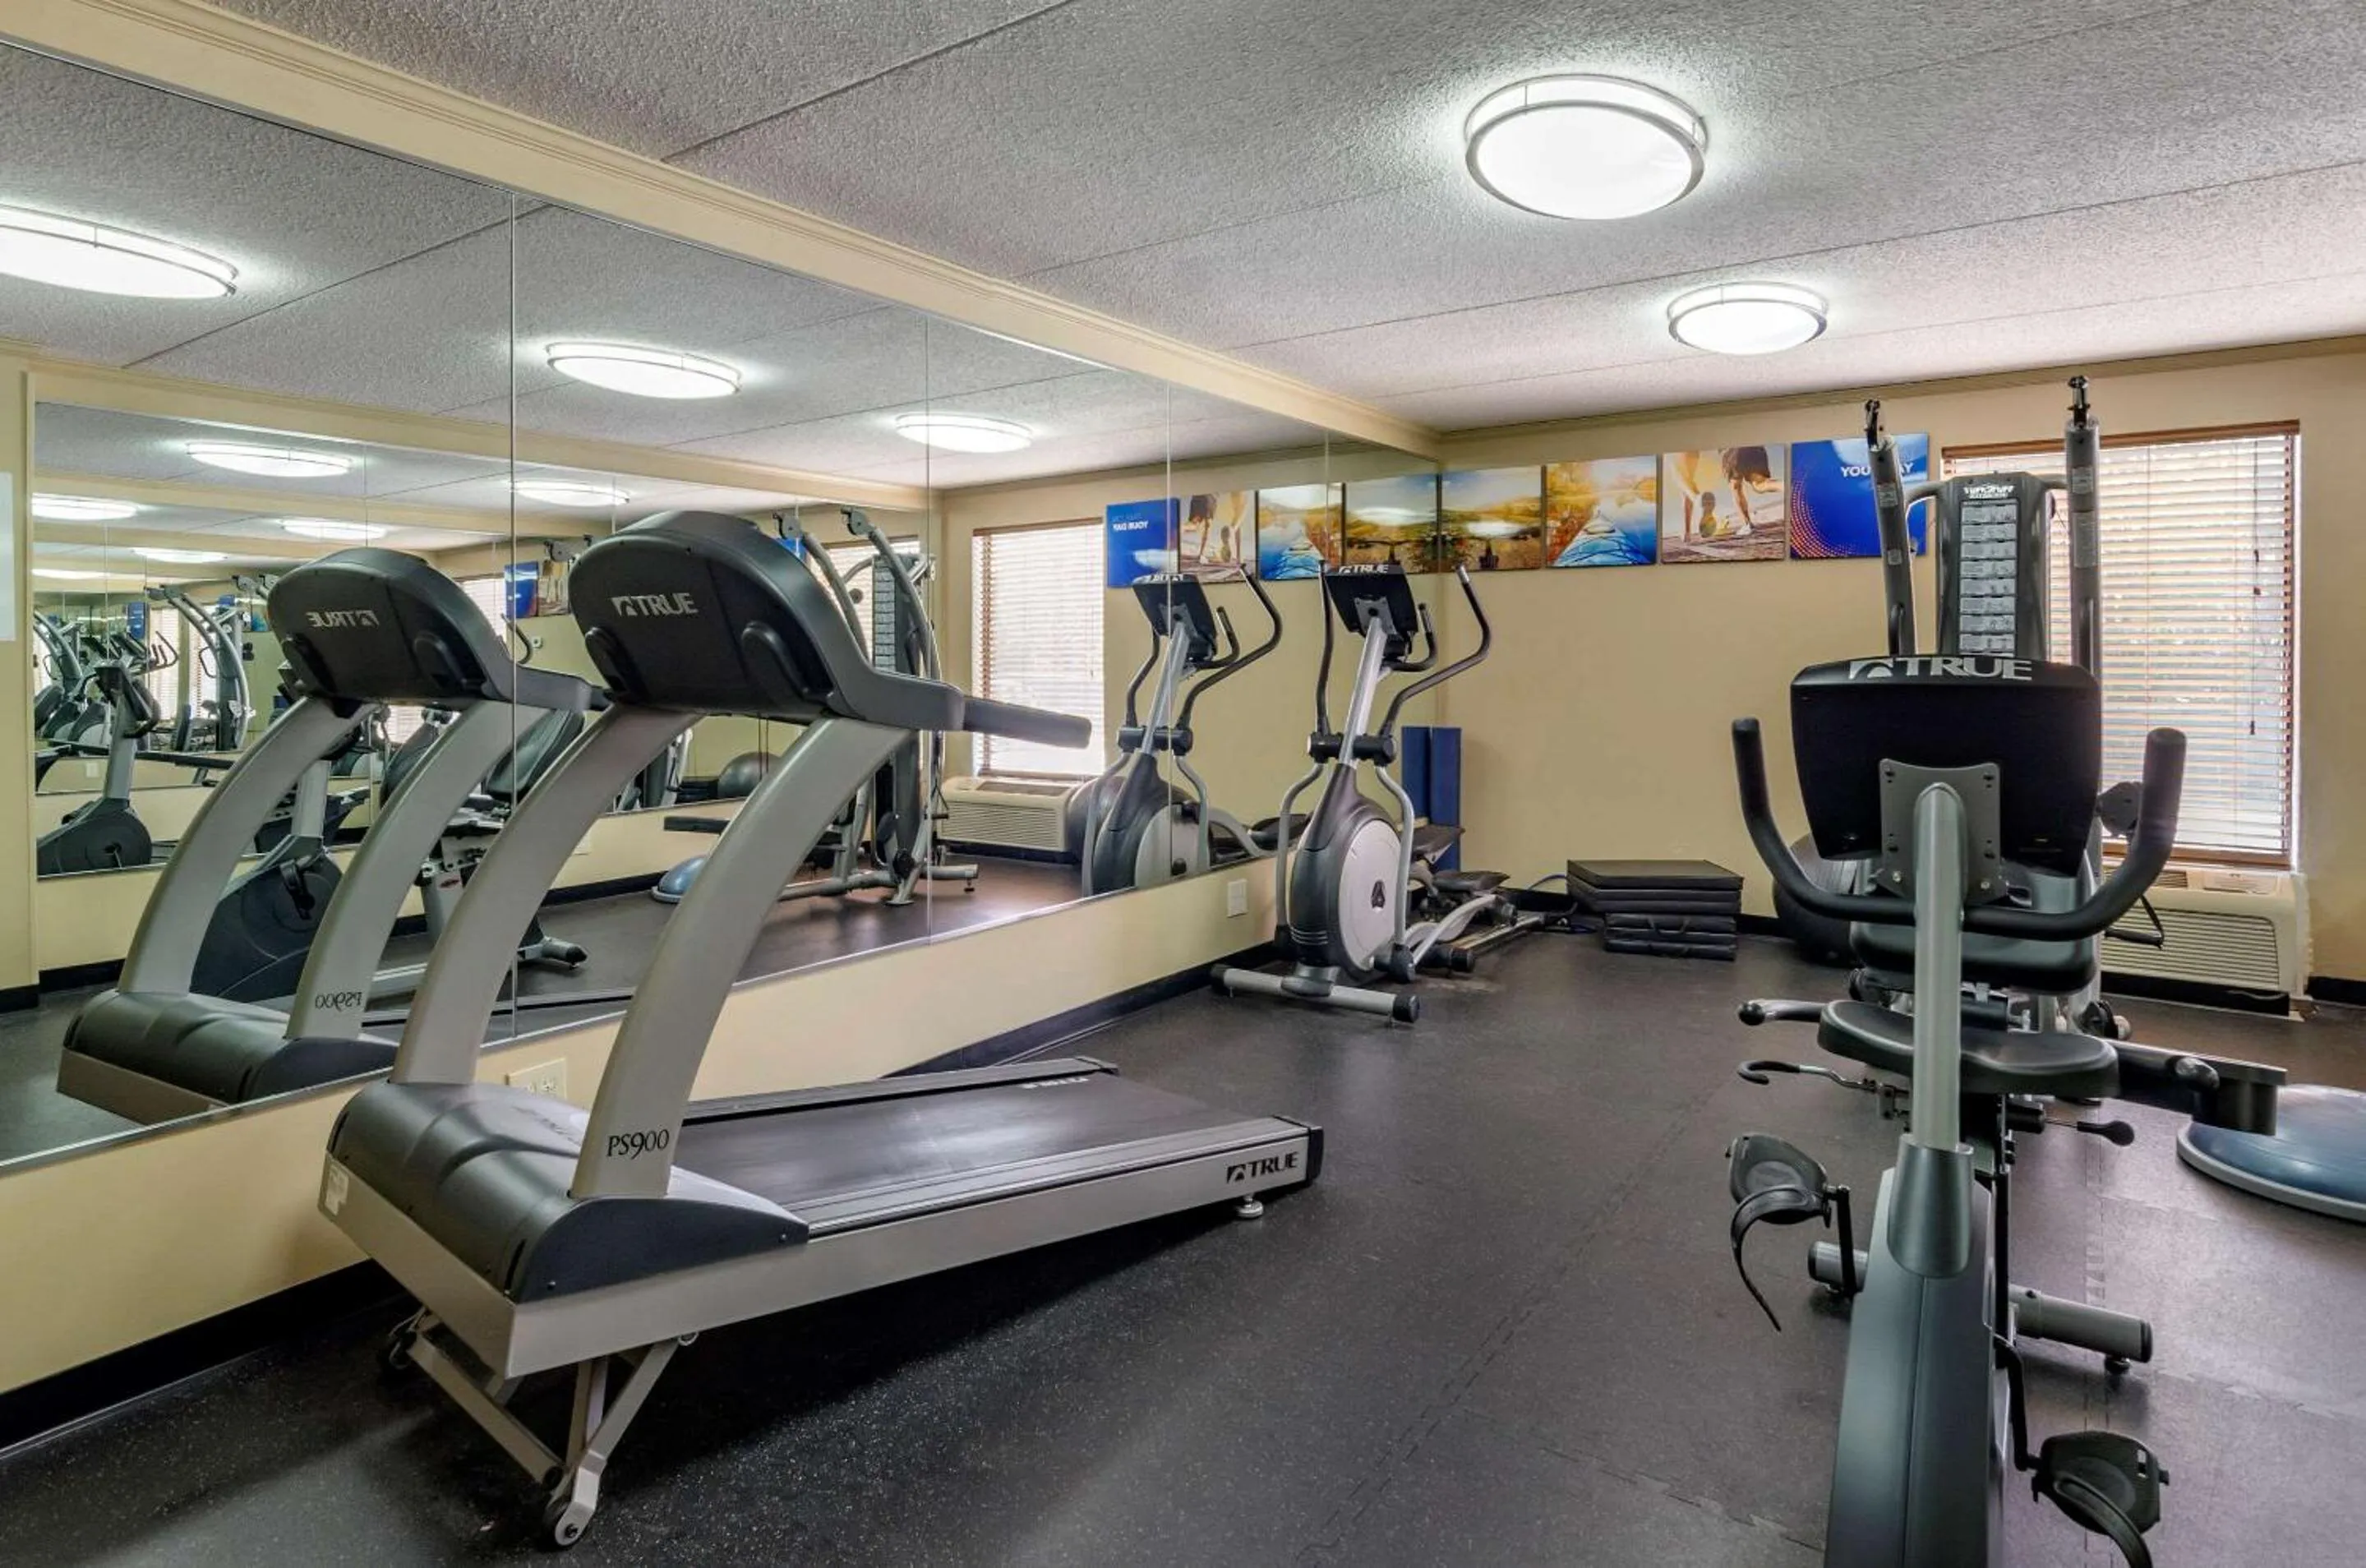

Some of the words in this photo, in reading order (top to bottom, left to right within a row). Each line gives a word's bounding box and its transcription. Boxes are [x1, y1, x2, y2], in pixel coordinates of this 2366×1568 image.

[1840, 466, 1871, 477] YOU
[630, 592, 699, 616] TRUE
[1896, 657, 2032, 681] TRUE
[606, 1128, 670, 1160] PS900
[1247, 1151, 1299, 1178] TRUE
